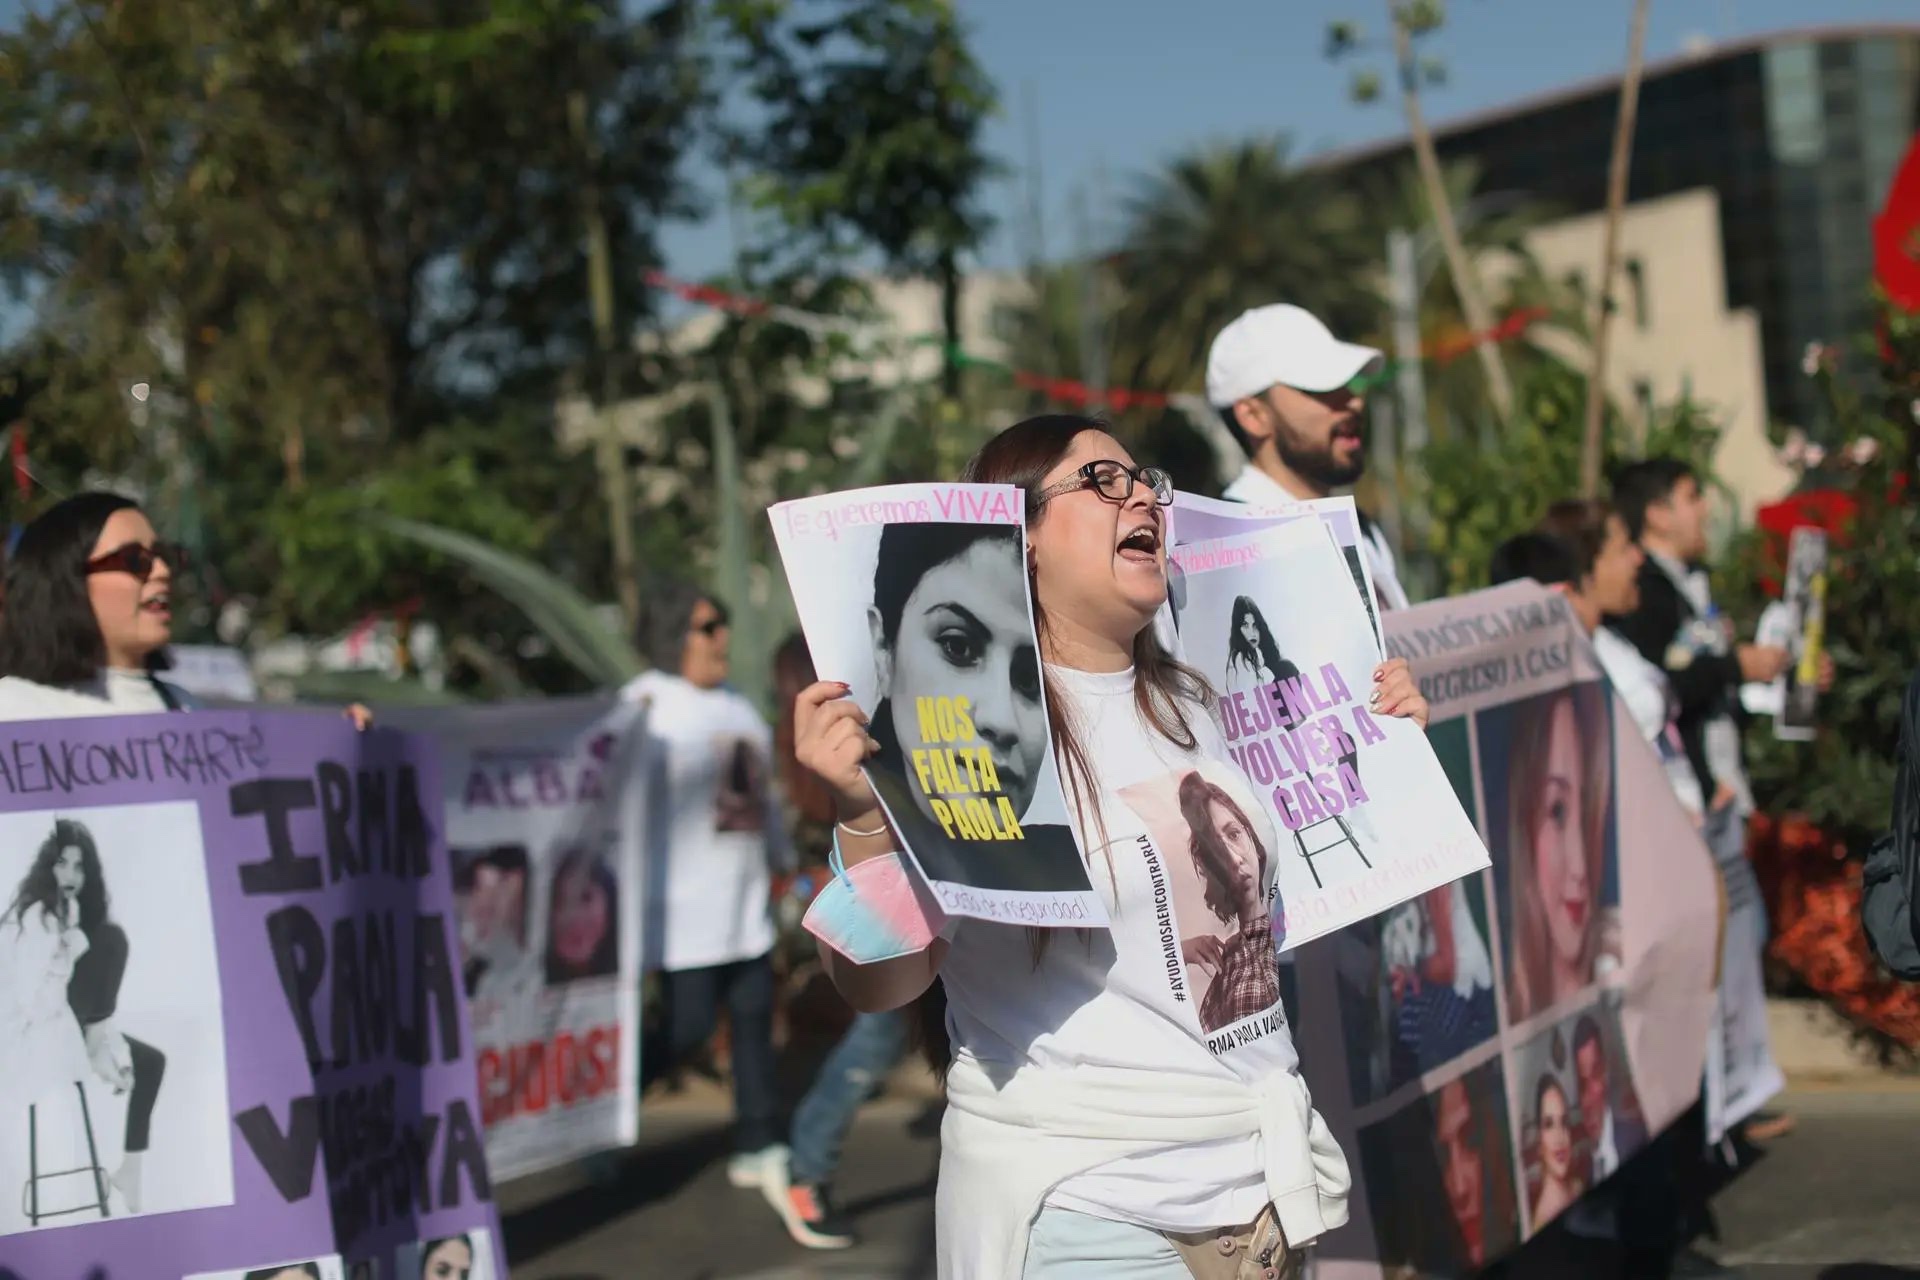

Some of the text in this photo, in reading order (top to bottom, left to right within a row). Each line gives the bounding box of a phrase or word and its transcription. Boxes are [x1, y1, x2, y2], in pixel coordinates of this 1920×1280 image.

[815, 498, 931, 541] queremos
[932, 488, 1020, 528] VIVA!
[1219, 662, 1353, 742] DEJENLA
[1419, 657, 1508, 705] REGRESO
[915, 694, 976, 744] NOS
[1228, 704, 1388, 786] VOLVER A
[911, 746, 1002, 795] FALTA
[1272, 761, 1371, 832] CASA
[229, 759, 434, 896] IRMA
[928, 796, 1025, 841] PAOLA
[1135, 834, 1187, 1003] #AYUDANOSAENCONTRARLA
[1232, 1020, 1263, 1047] PAOLA
